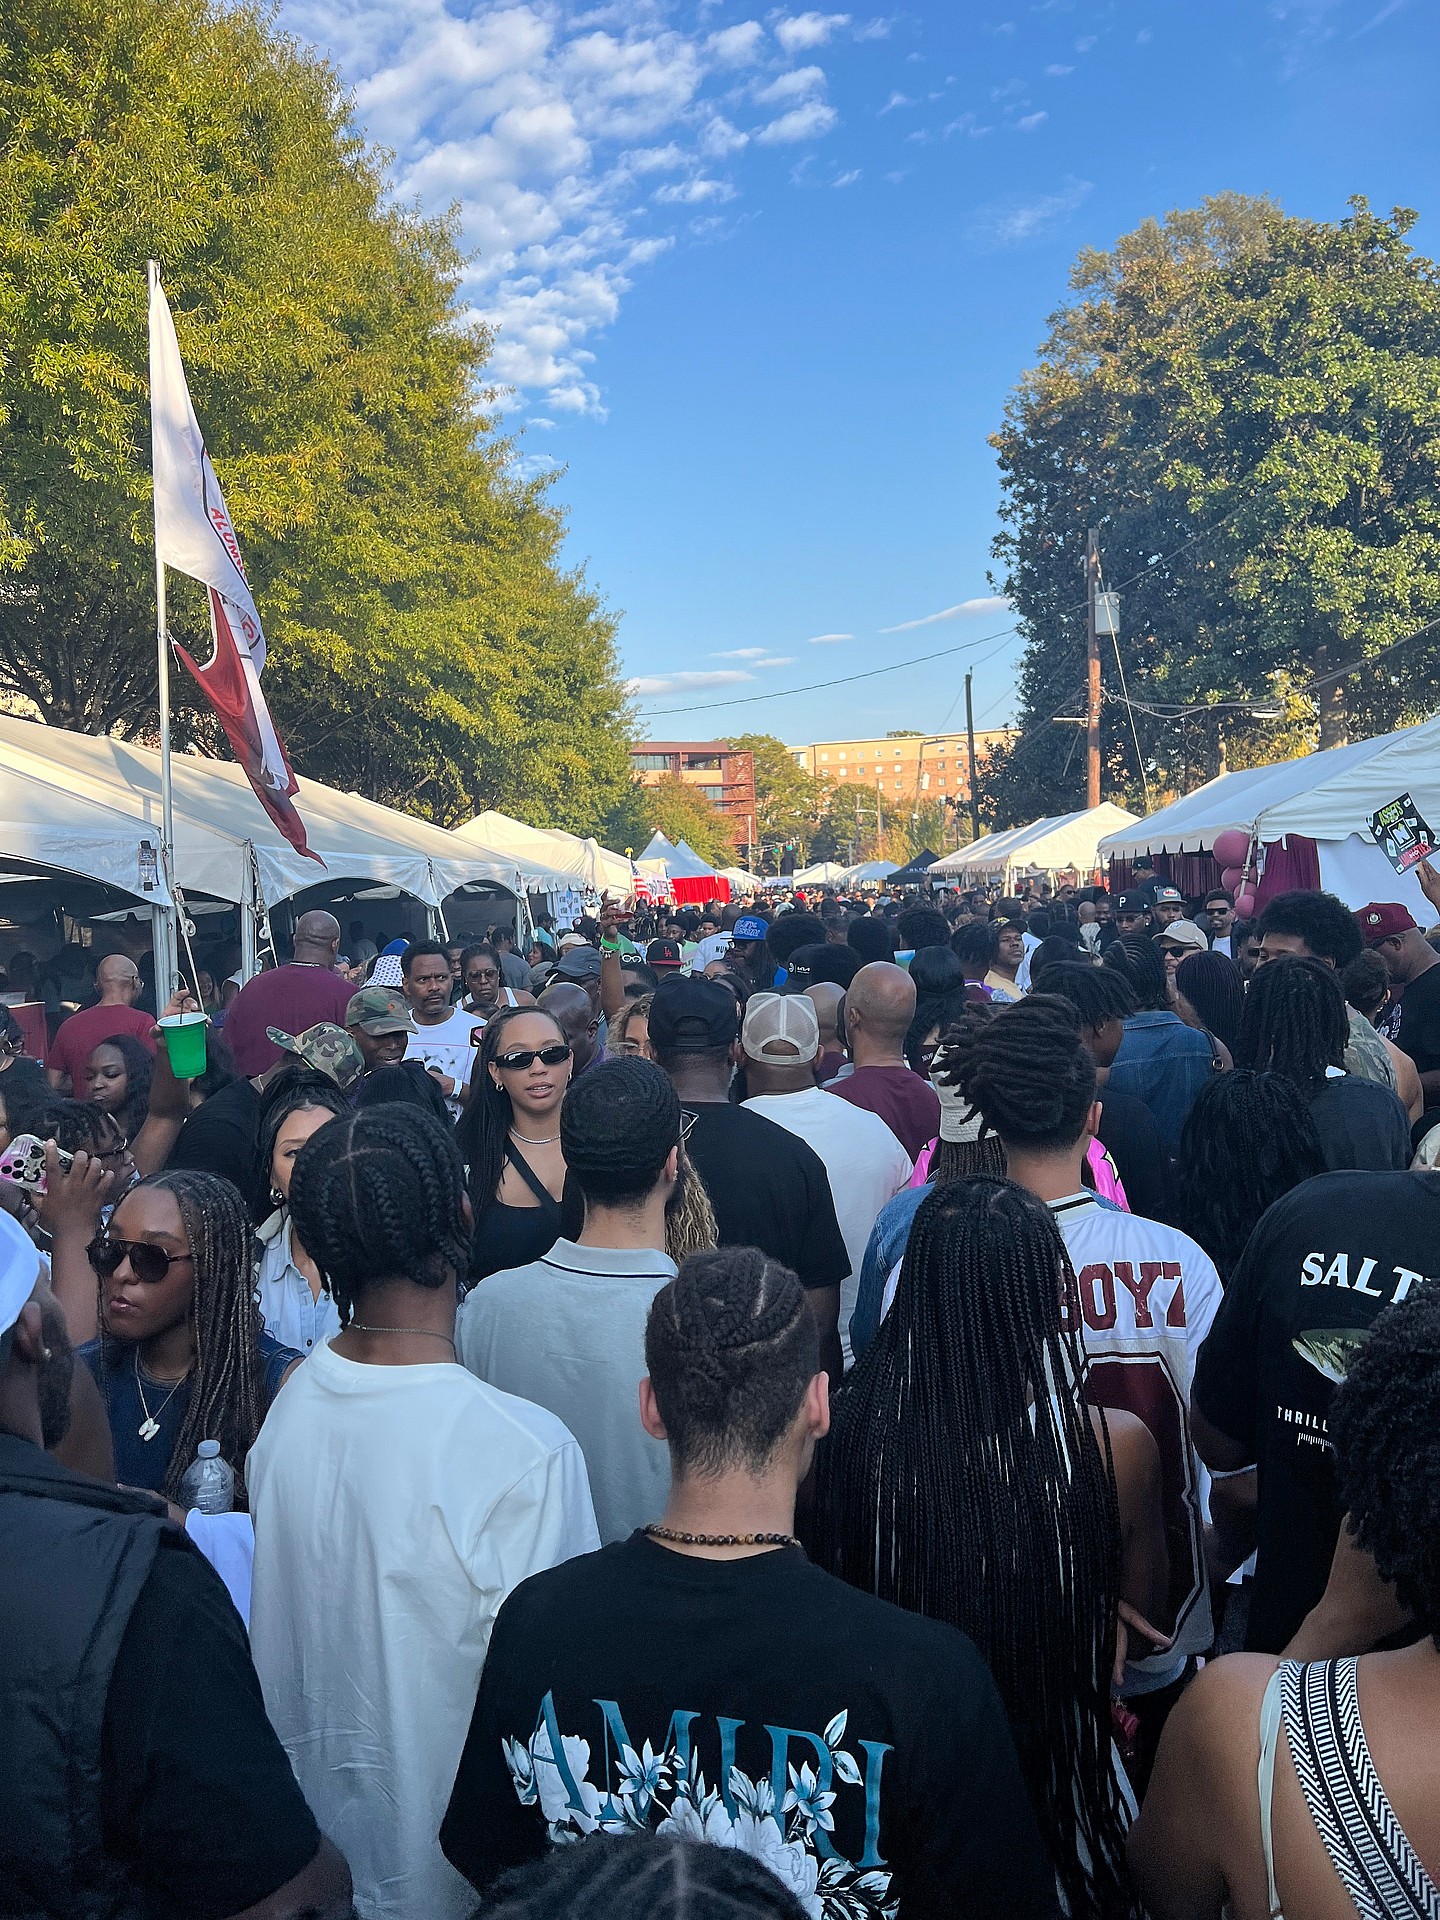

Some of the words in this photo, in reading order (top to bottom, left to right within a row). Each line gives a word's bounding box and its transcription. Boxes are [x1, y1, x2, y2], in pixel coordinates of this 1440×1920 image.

[1119, 896, 1127, 908] P
[1300, 1252, 1431, 1305] SALT
[527, 1689, 896, 1868] AMIRI
